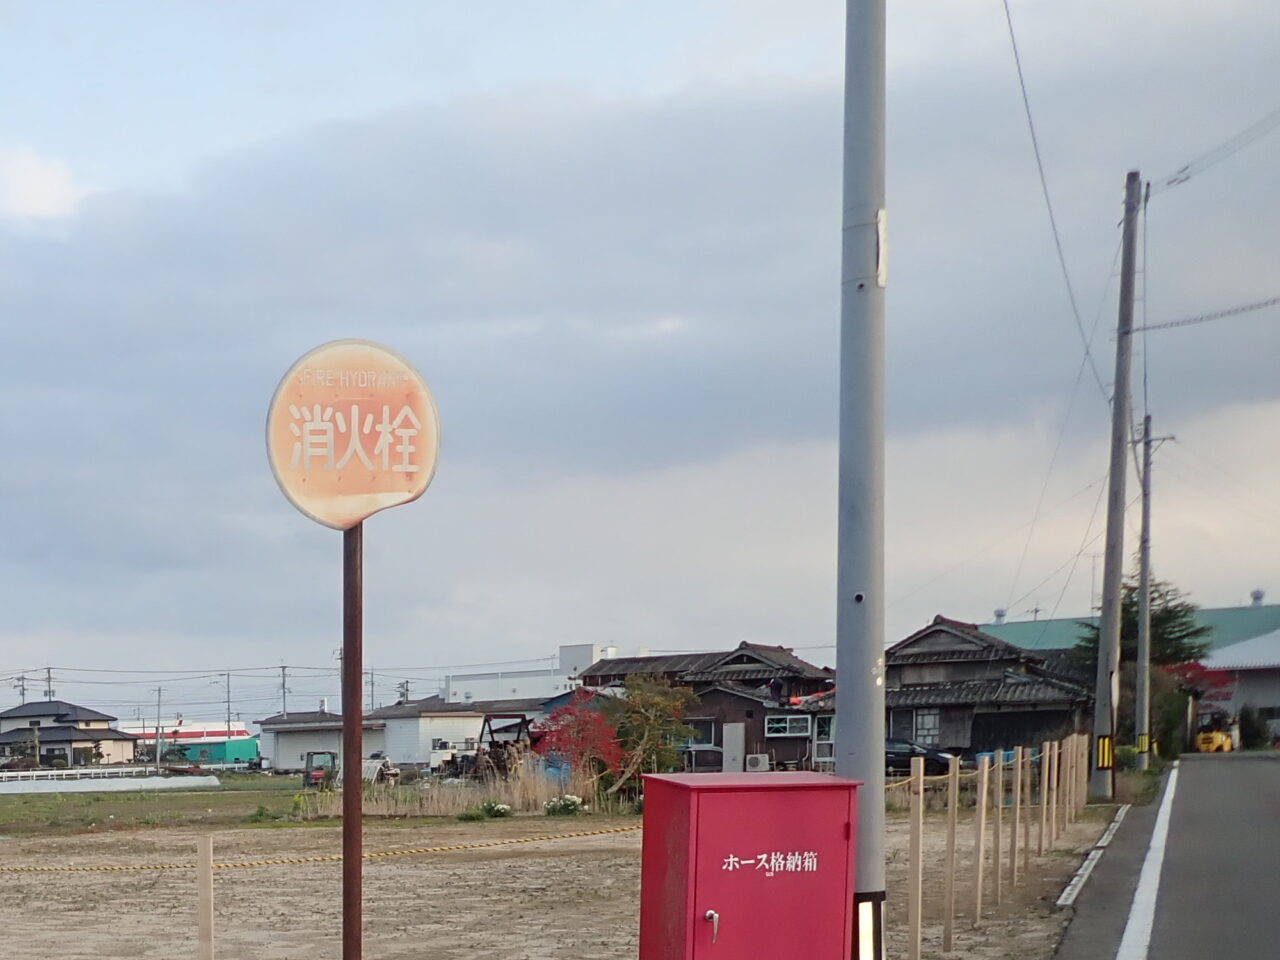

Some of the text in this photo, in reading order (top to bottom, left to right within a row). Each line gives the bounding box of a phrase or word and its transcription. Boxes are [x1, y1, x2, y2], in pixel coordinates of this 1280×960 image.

[288, 404, 421, 472] 消火栓
[722, 851, 818, 872] ホース格納箱
